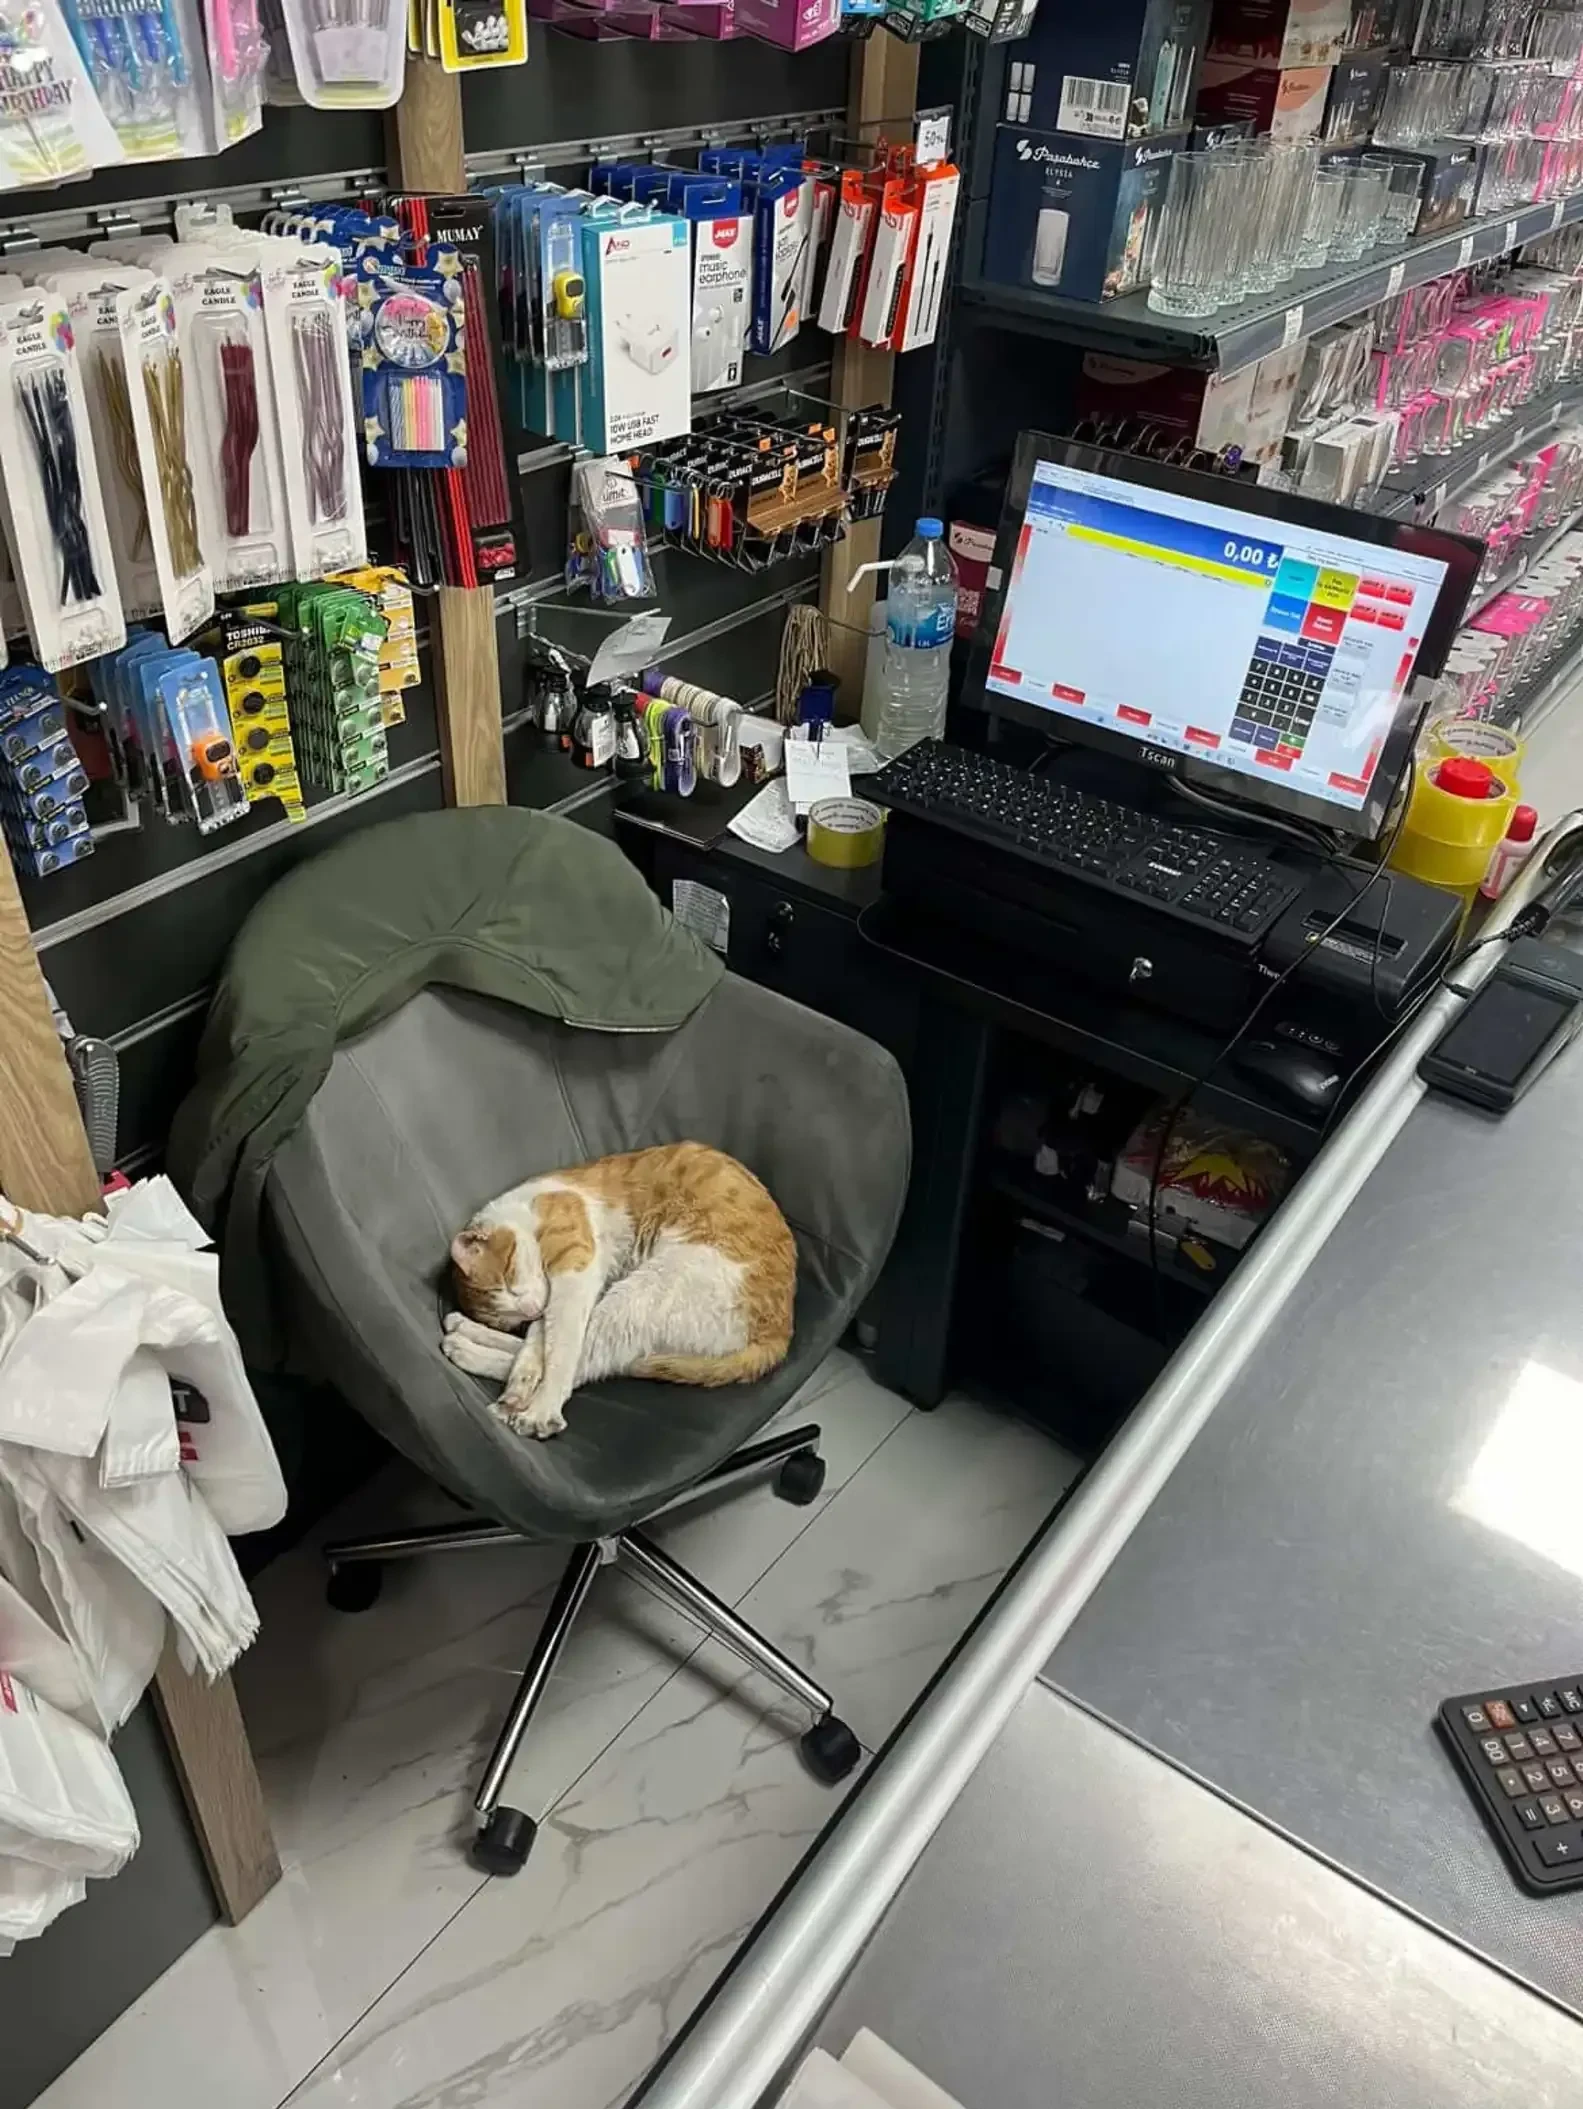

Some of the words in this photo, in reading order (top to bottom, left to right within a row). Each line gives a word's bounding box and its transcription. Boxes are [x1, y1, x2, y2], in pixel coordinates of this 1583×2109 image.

[437, 226, 481, 243] MUMAY
[699, 260, 728, 273] music
[201, 296, 237, 306] CANDLE
[15, 342, 47, 356] CANDLE
[1223, 540, 1264, 567] 0,00
[226, 635, 265, 651] CR2032
[1139, 746, 1177, 770] Tscan
[1556, 1731, 1574, 1741] 7
[1484, 1741, 1505, 1761] 00
[1509, 1741, 1525, 1749] 1
[1526, 1771, 1544, 1783] 2
[1551, 1766, 1568, 1778] 5
[1545, 1803, 1561, 1815] 3
